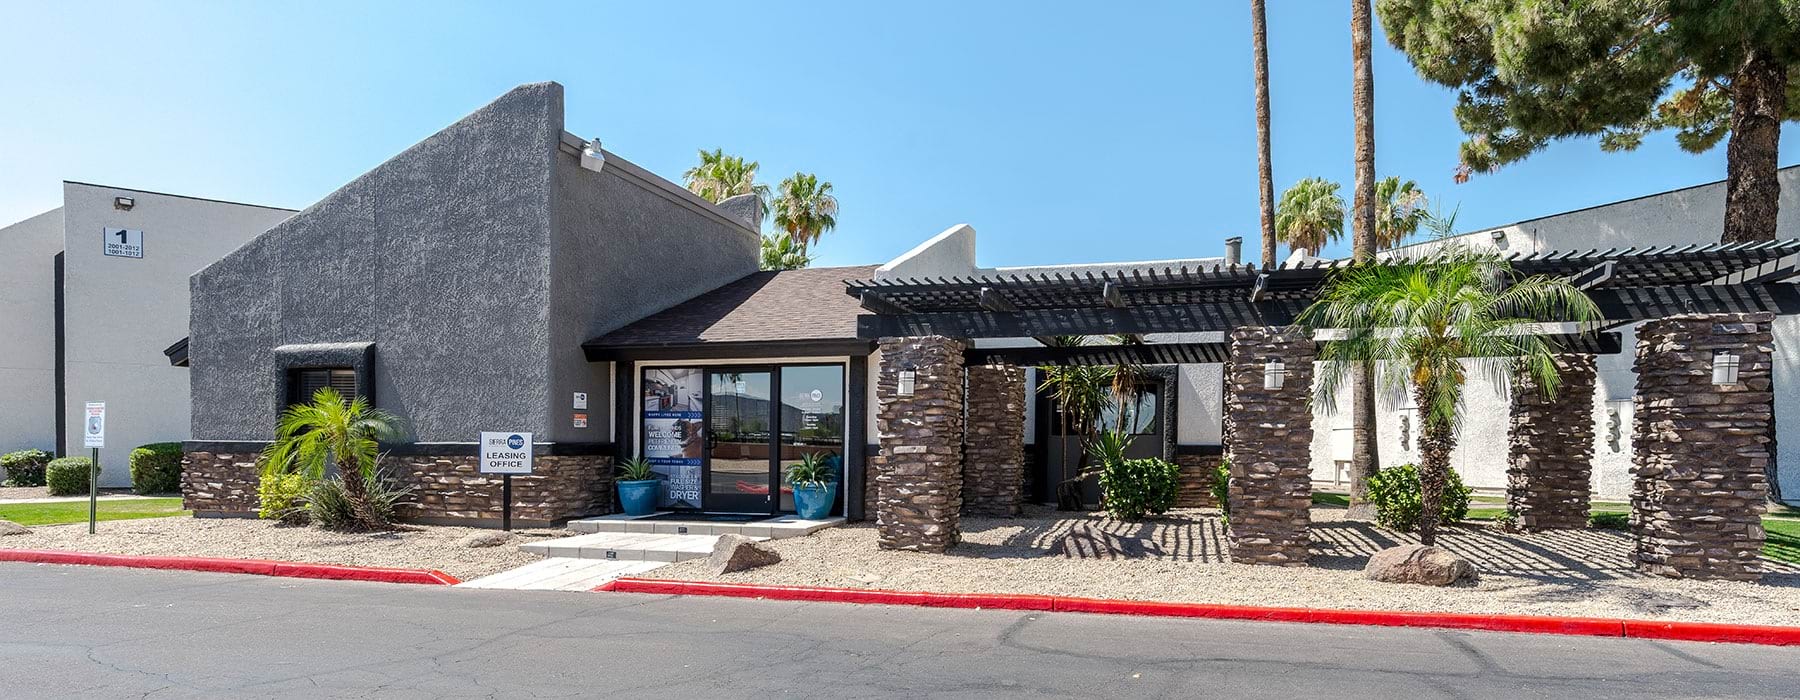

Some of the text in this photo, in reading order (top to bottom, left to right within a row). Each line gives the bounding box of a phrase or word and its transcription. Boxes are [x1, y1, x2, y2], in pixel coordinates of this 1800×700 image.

[115, 229, 127, 244] 1
[108, 243, 140, 251] 2001-2012
[648, 431, 682, 439] WELCOME
[486, 452, 526, 460] LEASING
[490, 460, 523, 468] OFFICE
[670, 490, 698, 500] DRYER
